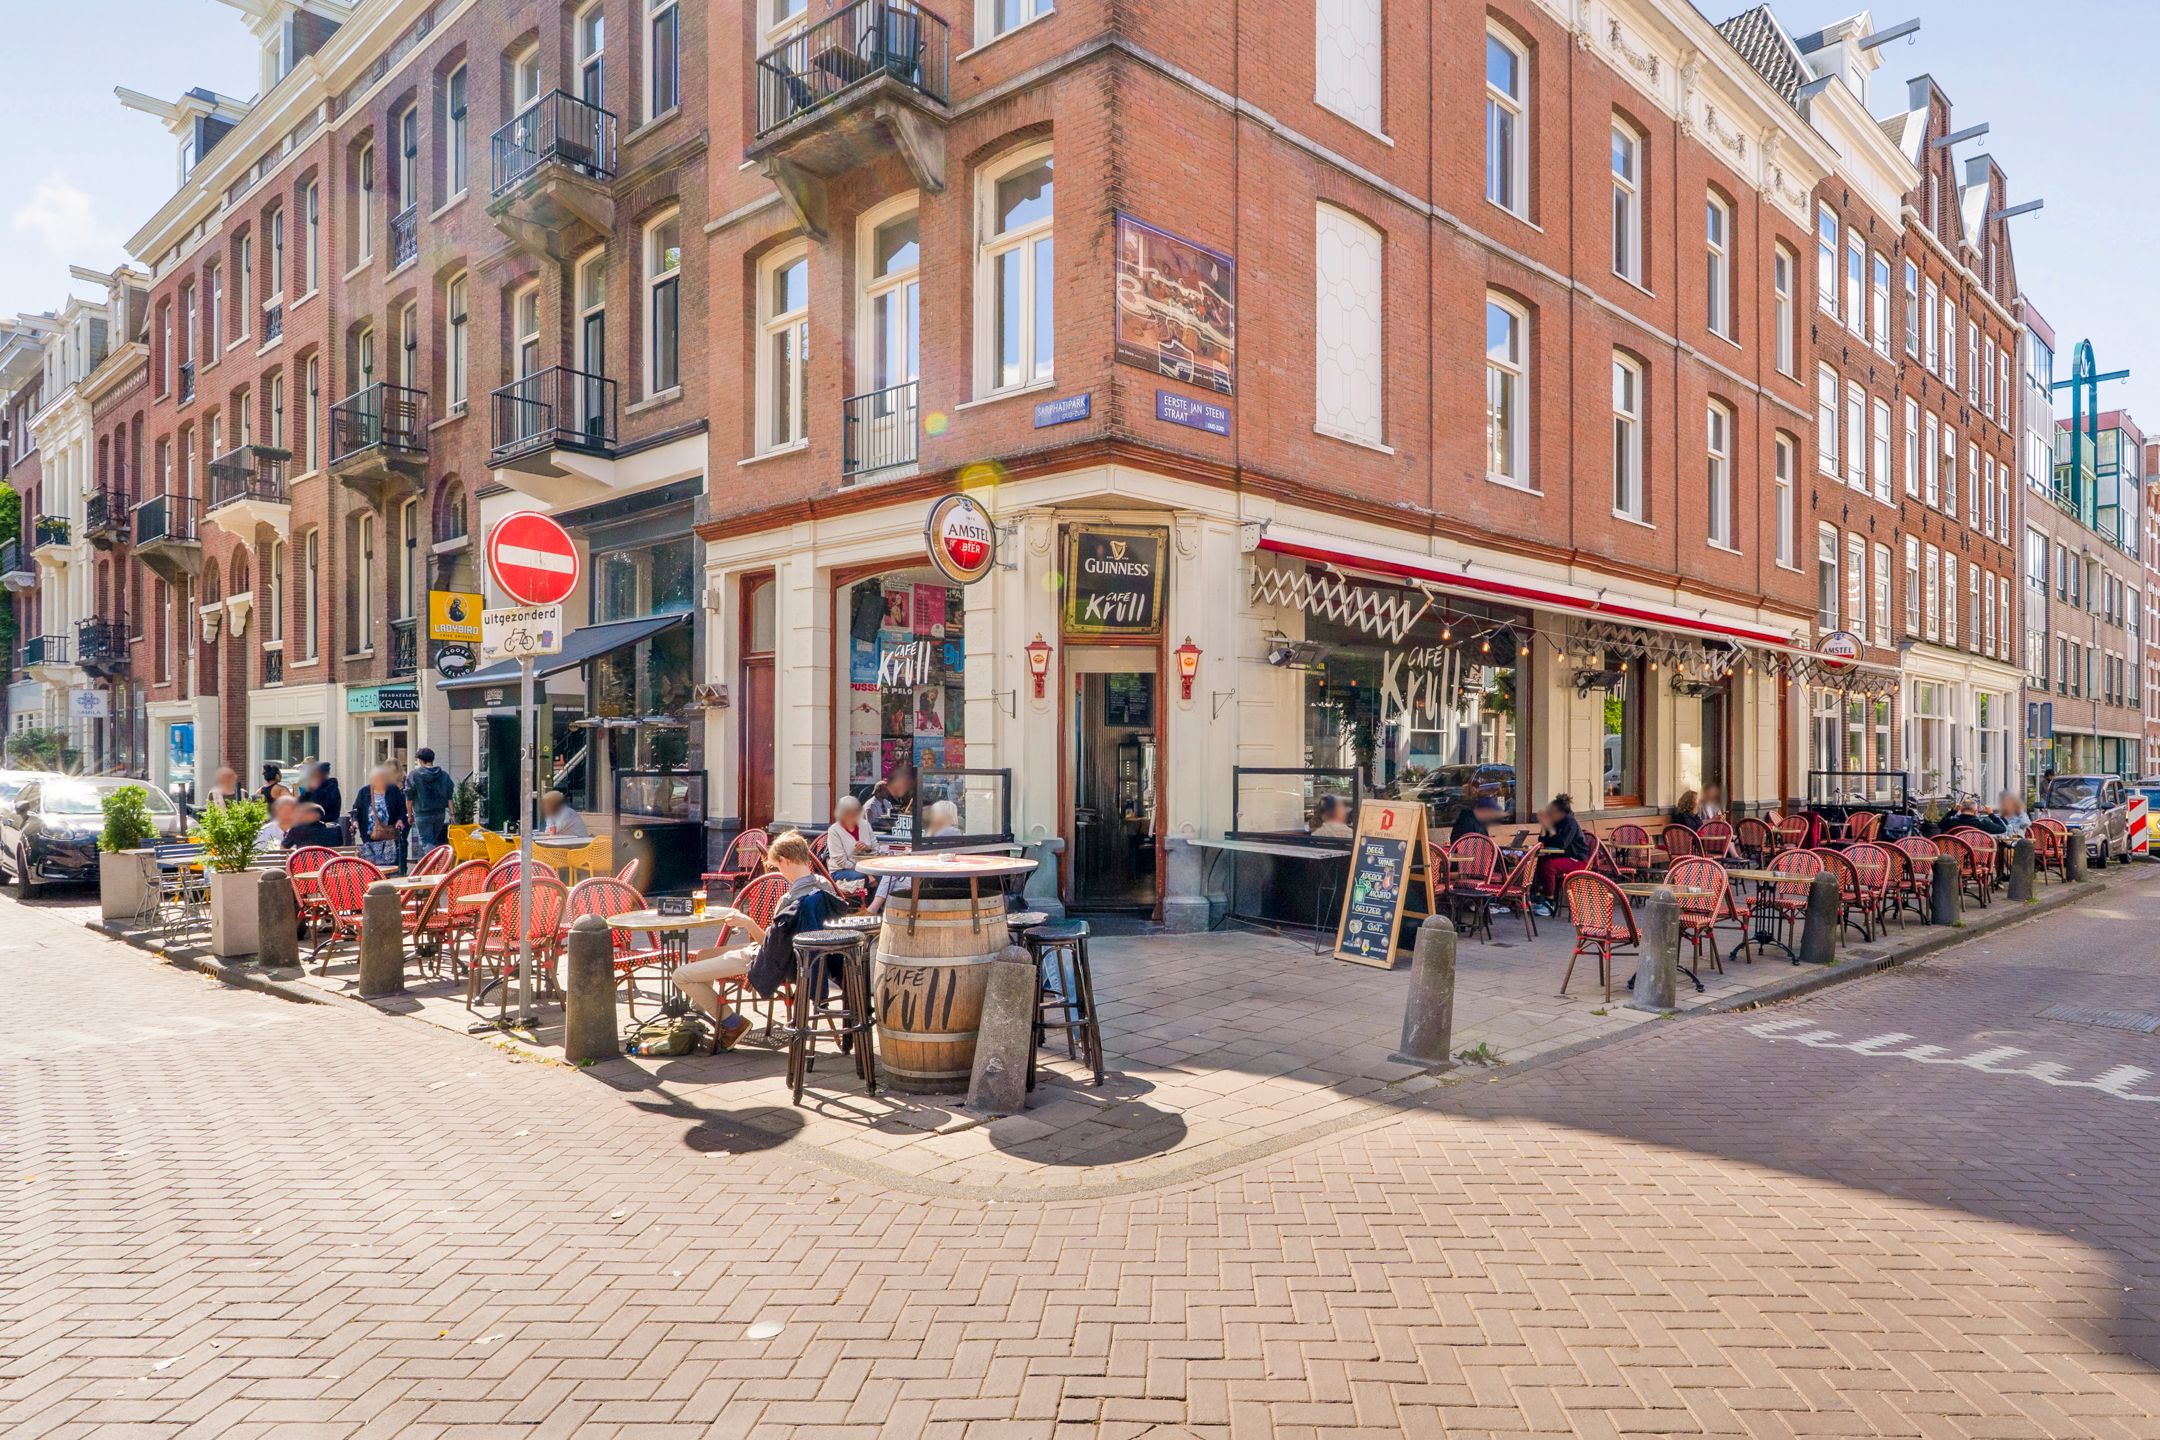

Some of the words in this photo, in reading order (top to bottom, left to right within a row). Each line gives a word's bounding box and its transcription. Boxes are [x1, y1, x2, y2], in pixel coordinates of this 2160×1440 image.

[1037, 396, 1086, 417] SARPHATIPARK
[1164, 395, 1187, 410] EERSTE
[1190, 401, 1203, 415] JAN
[1205, 406, 1225, 420] STEEN
[1164, 407, 1188, 422] STRAAT
[948, 523, 989, 542] AMSTEL
[962, 542, 981, 554] BIER
[1084, 557, 1149, 577] GUINNESS
[1105, 591, 1132, 602] CAFÉ
[1084, 592, 1145, 622] Krull
[484, 607, 556, 626] uitgezonderd
[434, 623, 479, 635] LADYBIRD
[445, 648, 470, 657] GOOSE
[894, 641, 918, 657] CAFÉ
[1407, 644, 1443, 668] CAFÉ
[444, 668, 471, 678] ISLAND
[877, 641, 931, 690] Krull
[891, 687, 913, 695] PELO
[1380, 647, 1461, 722] Krull
[379, 699, 419, 709] KRALEN
[1381, 809, 1394, 831] D
[1366, 846, 1384, 854] BEER
[1360, 872, 1382, 881] APEROL
[1368, 890, 1391, 899] MOJITO
[1354, 904, 1381, 915] SELTZER
[885, 967, 926, 987] CAFÉ
